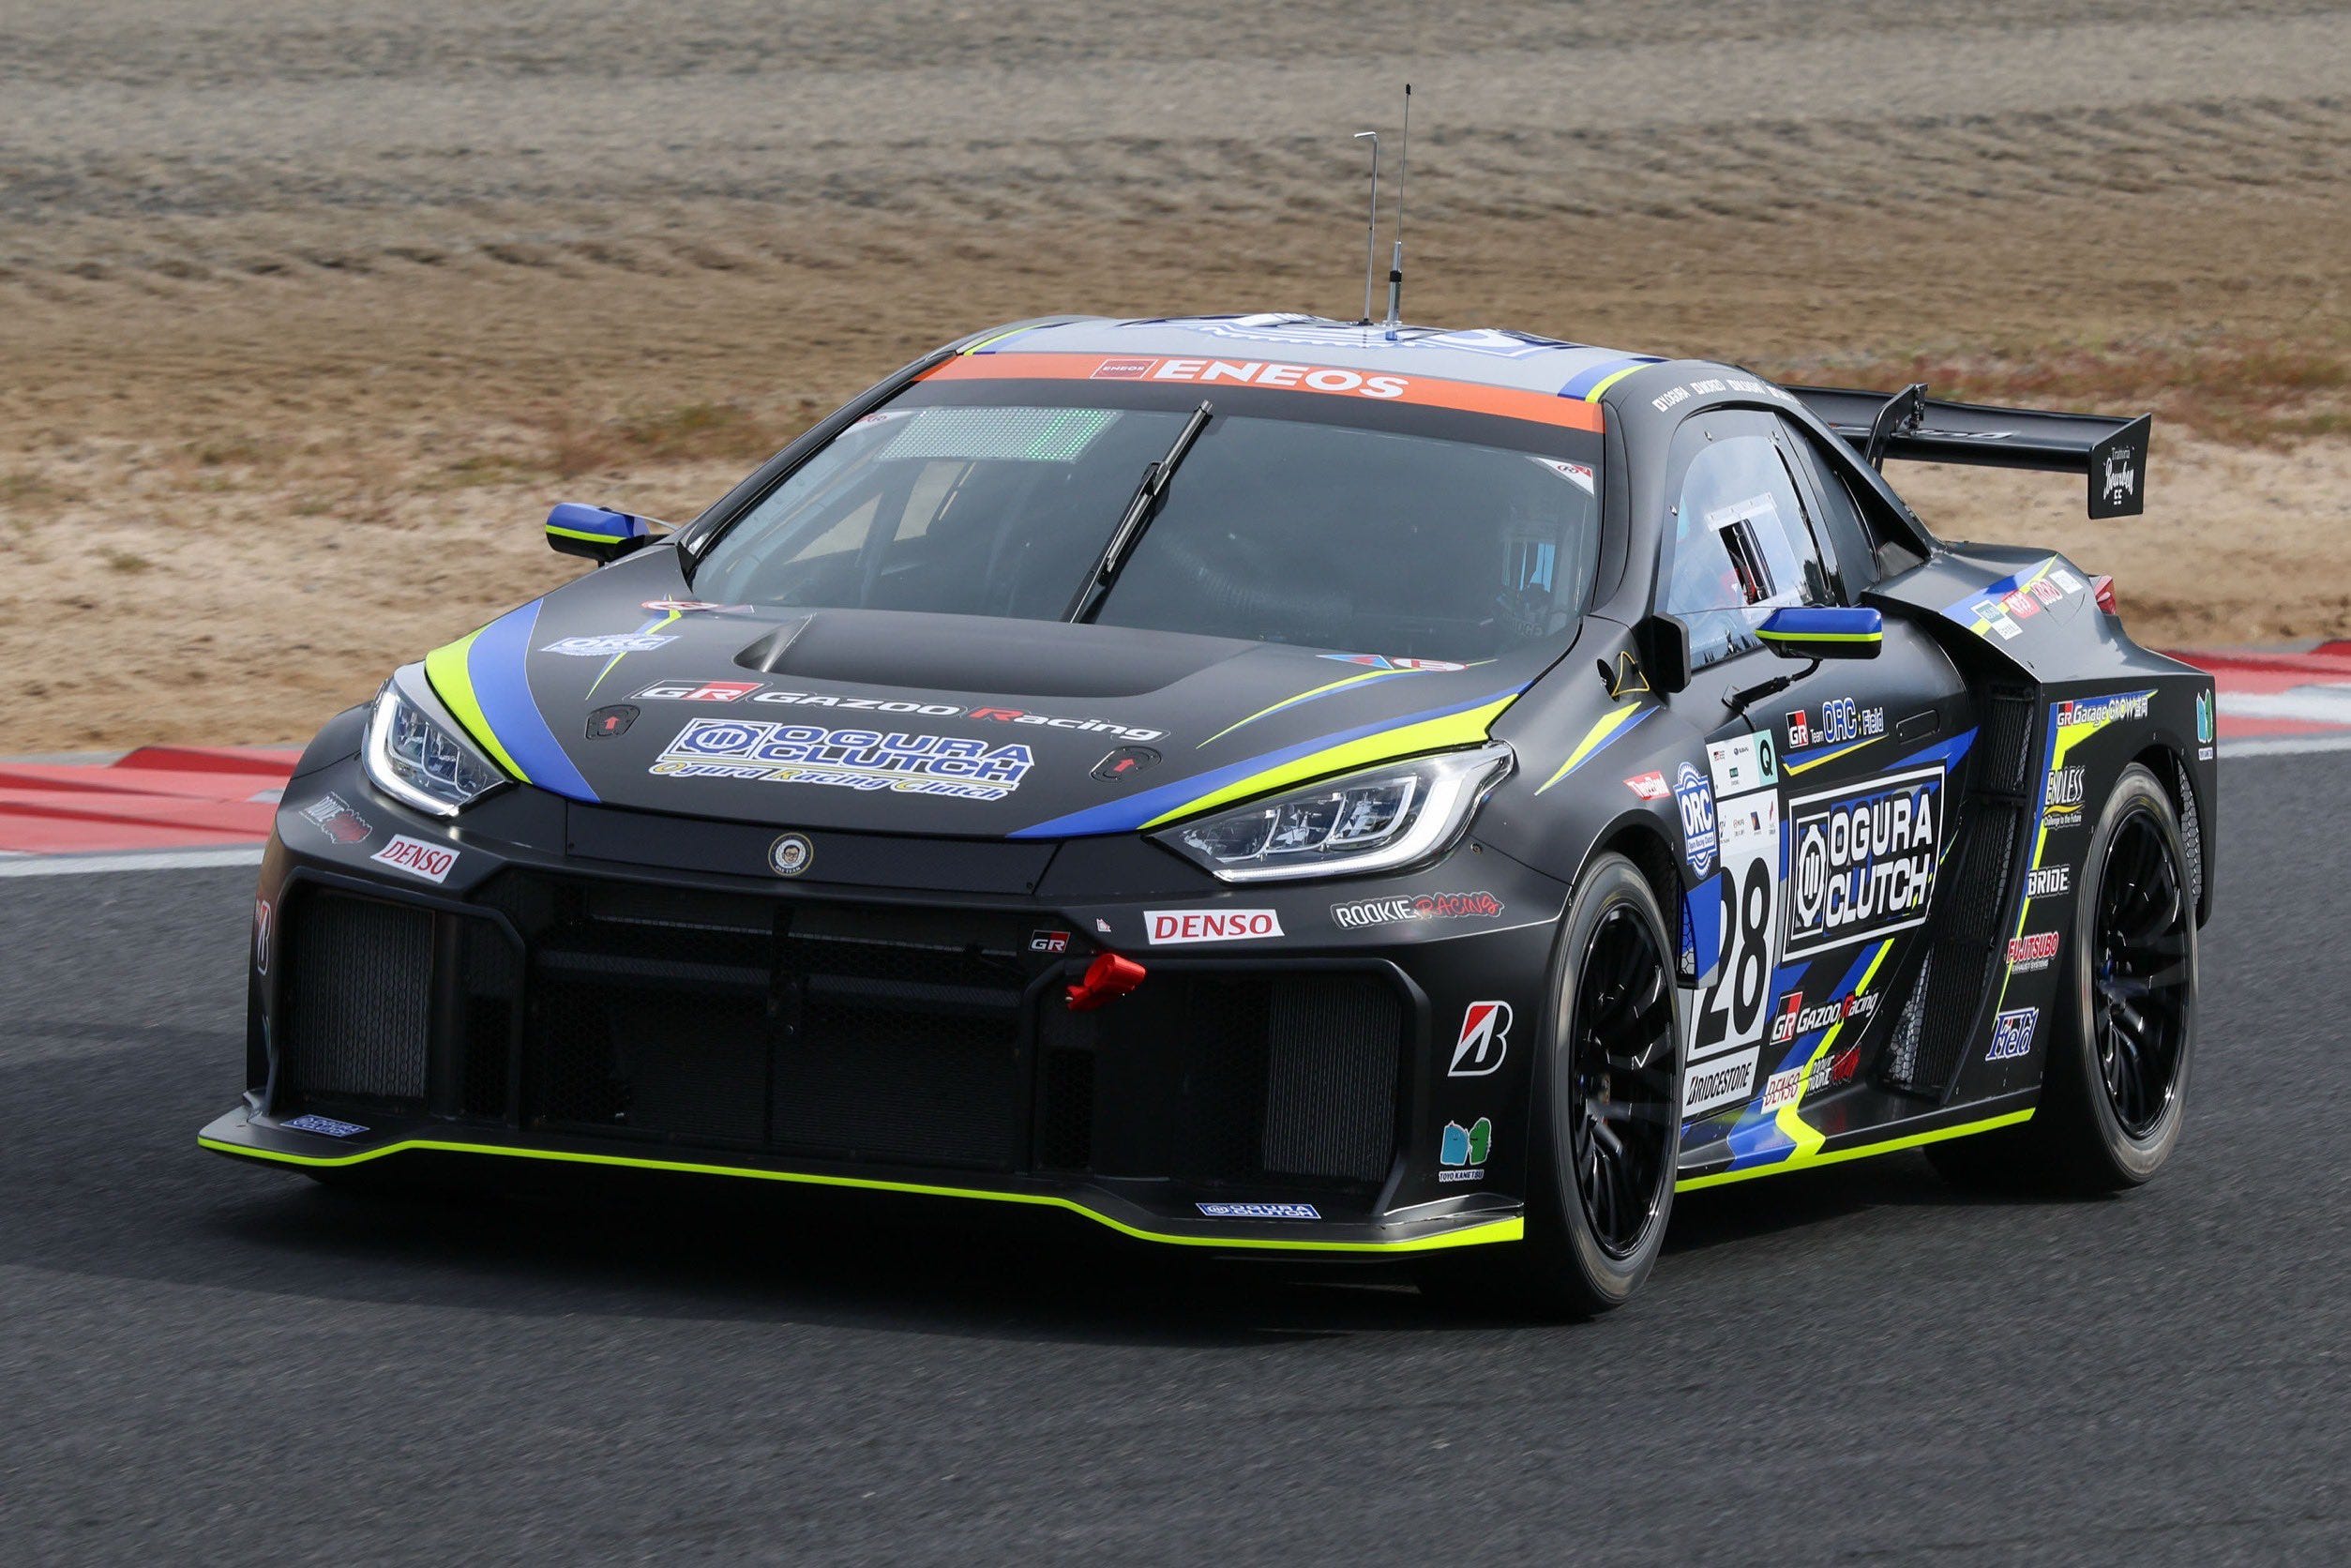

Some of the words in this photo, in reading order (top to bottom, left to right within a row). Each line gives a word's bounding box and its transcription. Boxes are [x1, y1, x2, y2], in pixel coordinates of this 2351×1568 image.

[1101, 364, 1146, 372] ENEOS
[1153, 359, 1409, 399] ENEOS
[640, 686, 739, 701] GR
[752, 691, 960, 716] GAZOO
[969, 707, 1163, 742] Racing
[1810, 729, 1824, 744] Team
[1822, 697, 1857, 743] ORC
[1862, 707, 1884, 735] Field
[2072, 704, 2108, 727] Garage
[751, 743, 1030, 783] CLUTCH
[766, 725, 1033, 764] OGURA
[1759, 739, 1773, 776] Q
[649, 761, 766, 779] Ogura
[766, 766, 892, 791] Racing
[892, 776, 1010, 802] Clutch
[2045, 769, 2085, 806] ENDLESS
[1681, 789, 1712, 837] ORC
[1830, 792, 1933, 867] OGURA
[381, 840, 453, 875] DENSO
[1824, 854, 1931, 927] CLUTCH
[2027, 867, 2070, 897] BRIDE
[1154, 912, 1273, 939] DENSO
[1335, 899, 1417, 927] ROOKIE
[1415, 894, 1500, 917] RACING
[1032, 939, 1065, 952] GR
[1695, 856, 1771, 1048] 28
[2006, 931, 2059, 963] FUJITSUBO
[1771, 1011, 1798, 1041] GR
[1797, 1002, 1842, 1034] GAZOO
[1840, 989, 1879, 1018] Racing
[1985, 1006, 2040, 1062] Field
[1686, 1062, 1753, 1107] BRIDGESTONE
[1764, 1072, 1801, 1107] DENSO
